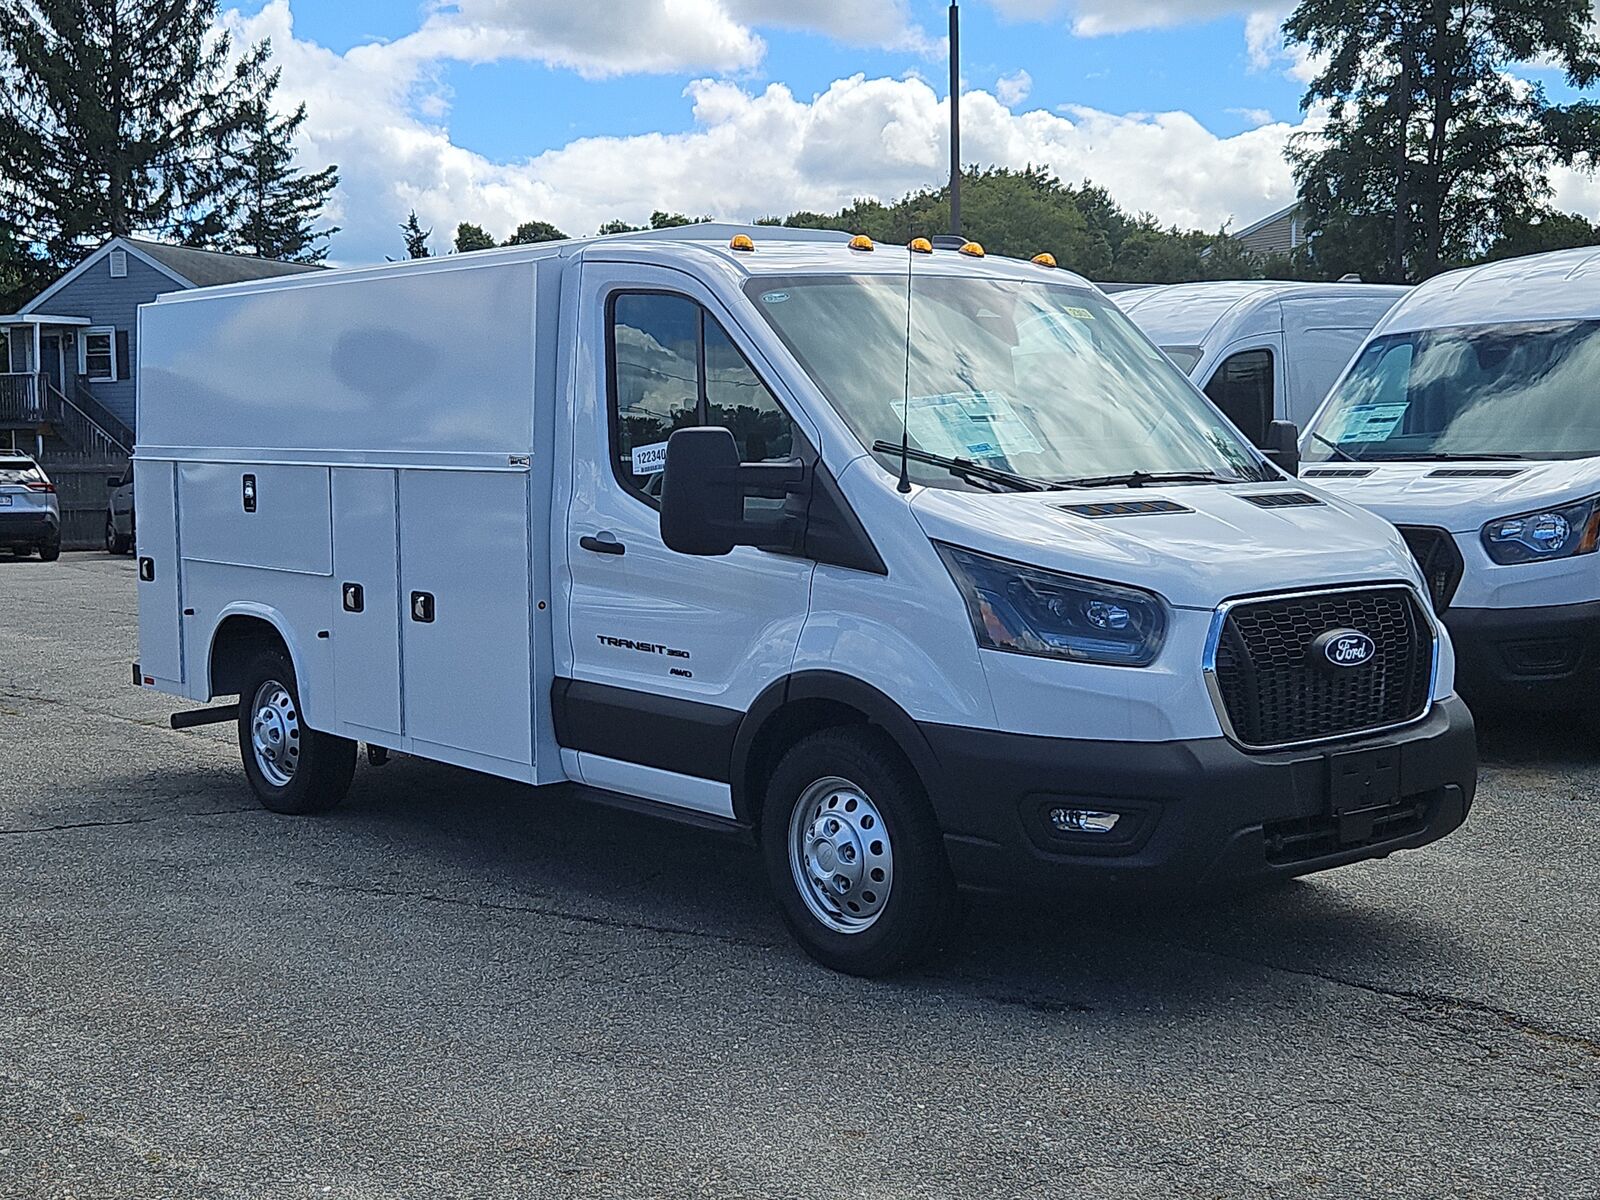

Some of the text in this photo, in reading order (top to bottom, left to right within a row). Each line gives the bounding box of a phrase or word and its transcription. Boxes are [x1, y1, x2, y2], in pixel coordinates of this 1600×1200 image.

[637, 448, 666, 464] 122340
[597, 634, 666, 655] TRANSIT
[1336, 638, 1366, 661] Ford
[669, 667, 693, 678] AWD
